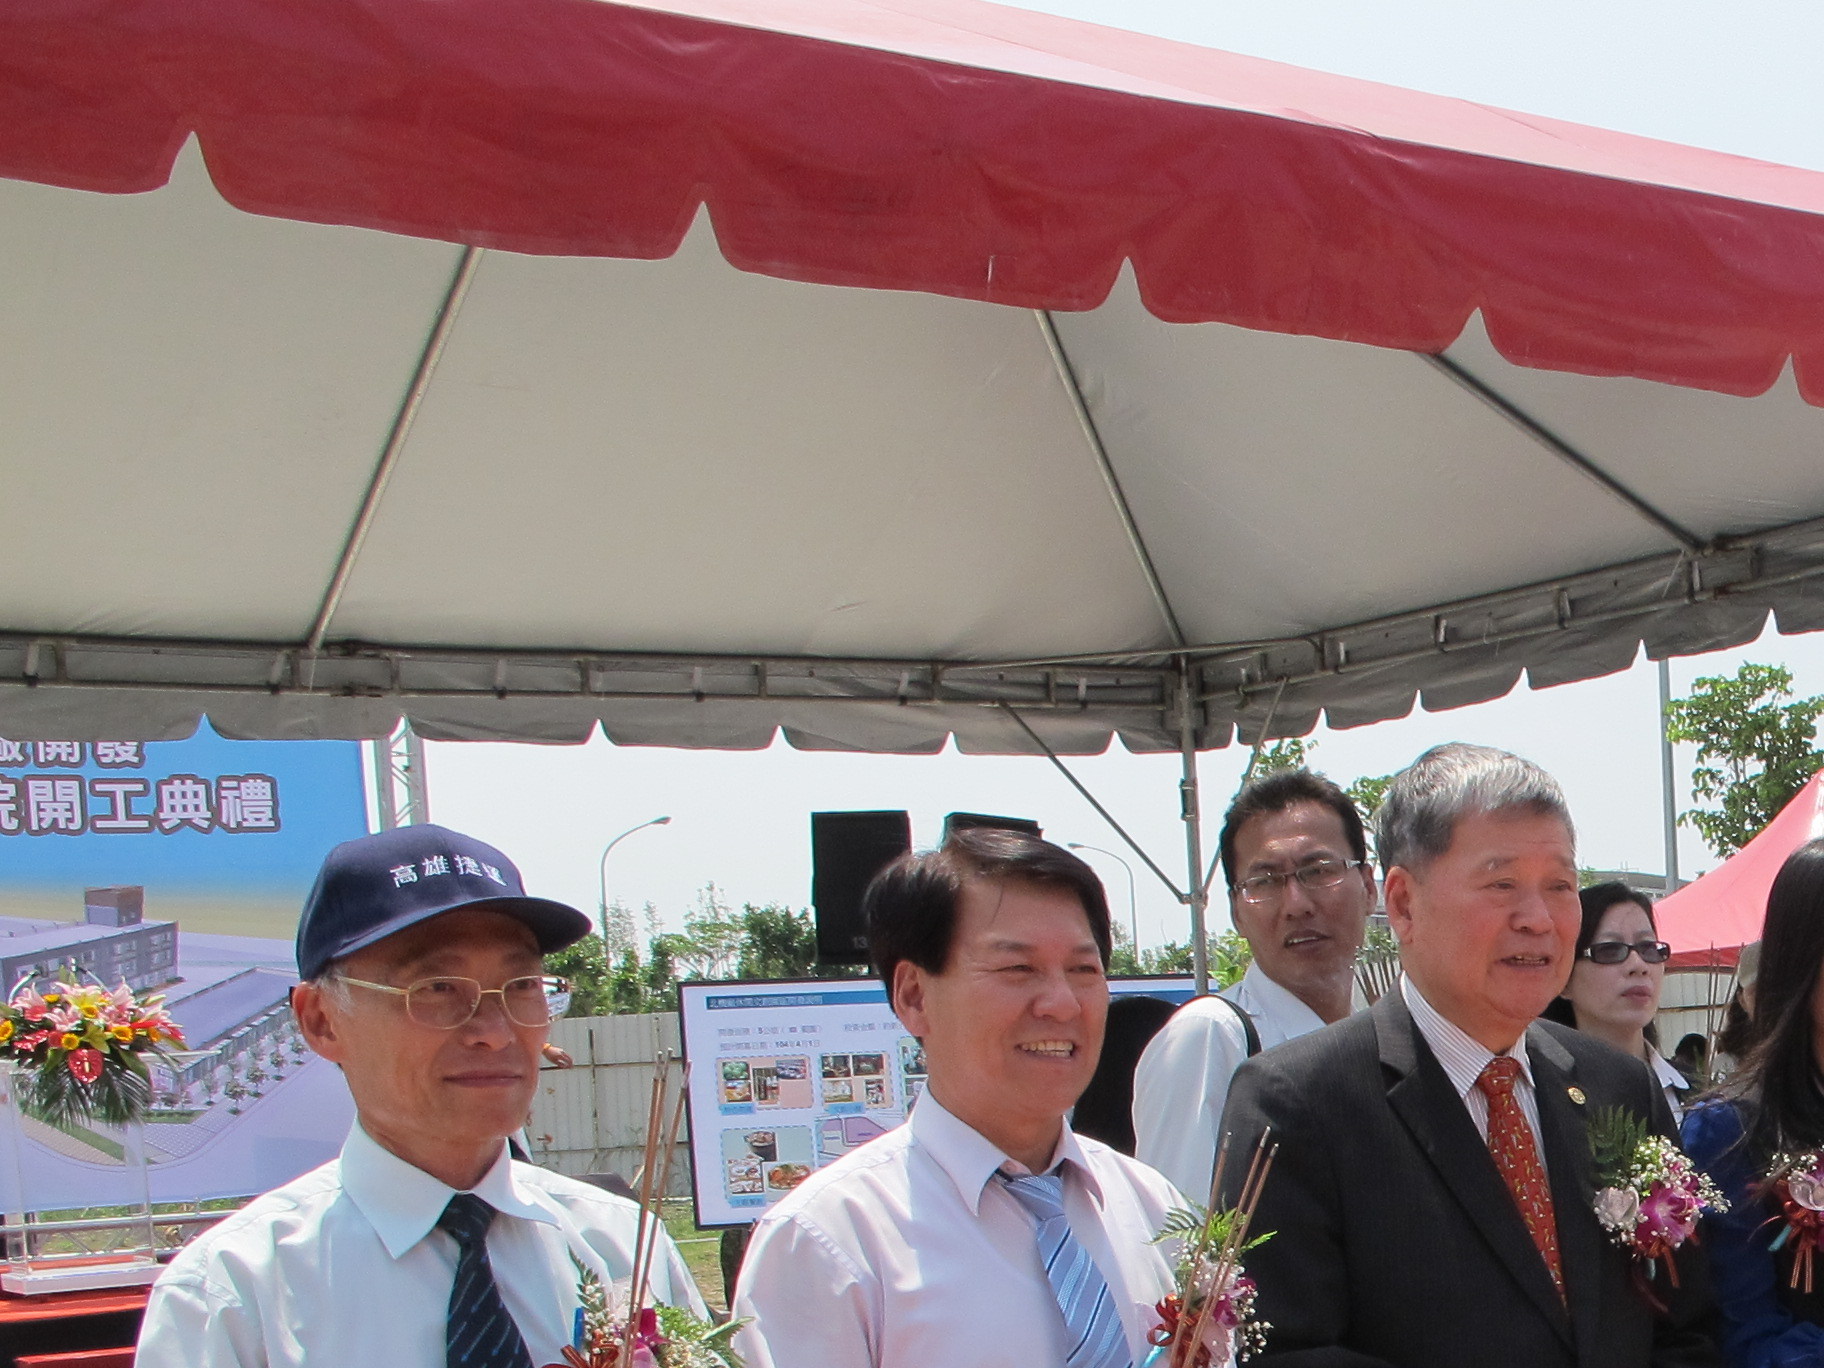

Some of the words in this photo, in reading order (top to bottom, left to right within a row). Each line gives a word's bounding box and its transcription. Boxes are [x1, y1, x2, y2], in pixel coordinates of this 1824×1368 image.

[0, 741, 142, 764] 開發
[389, 853, 508, 889] 高雄捷運
